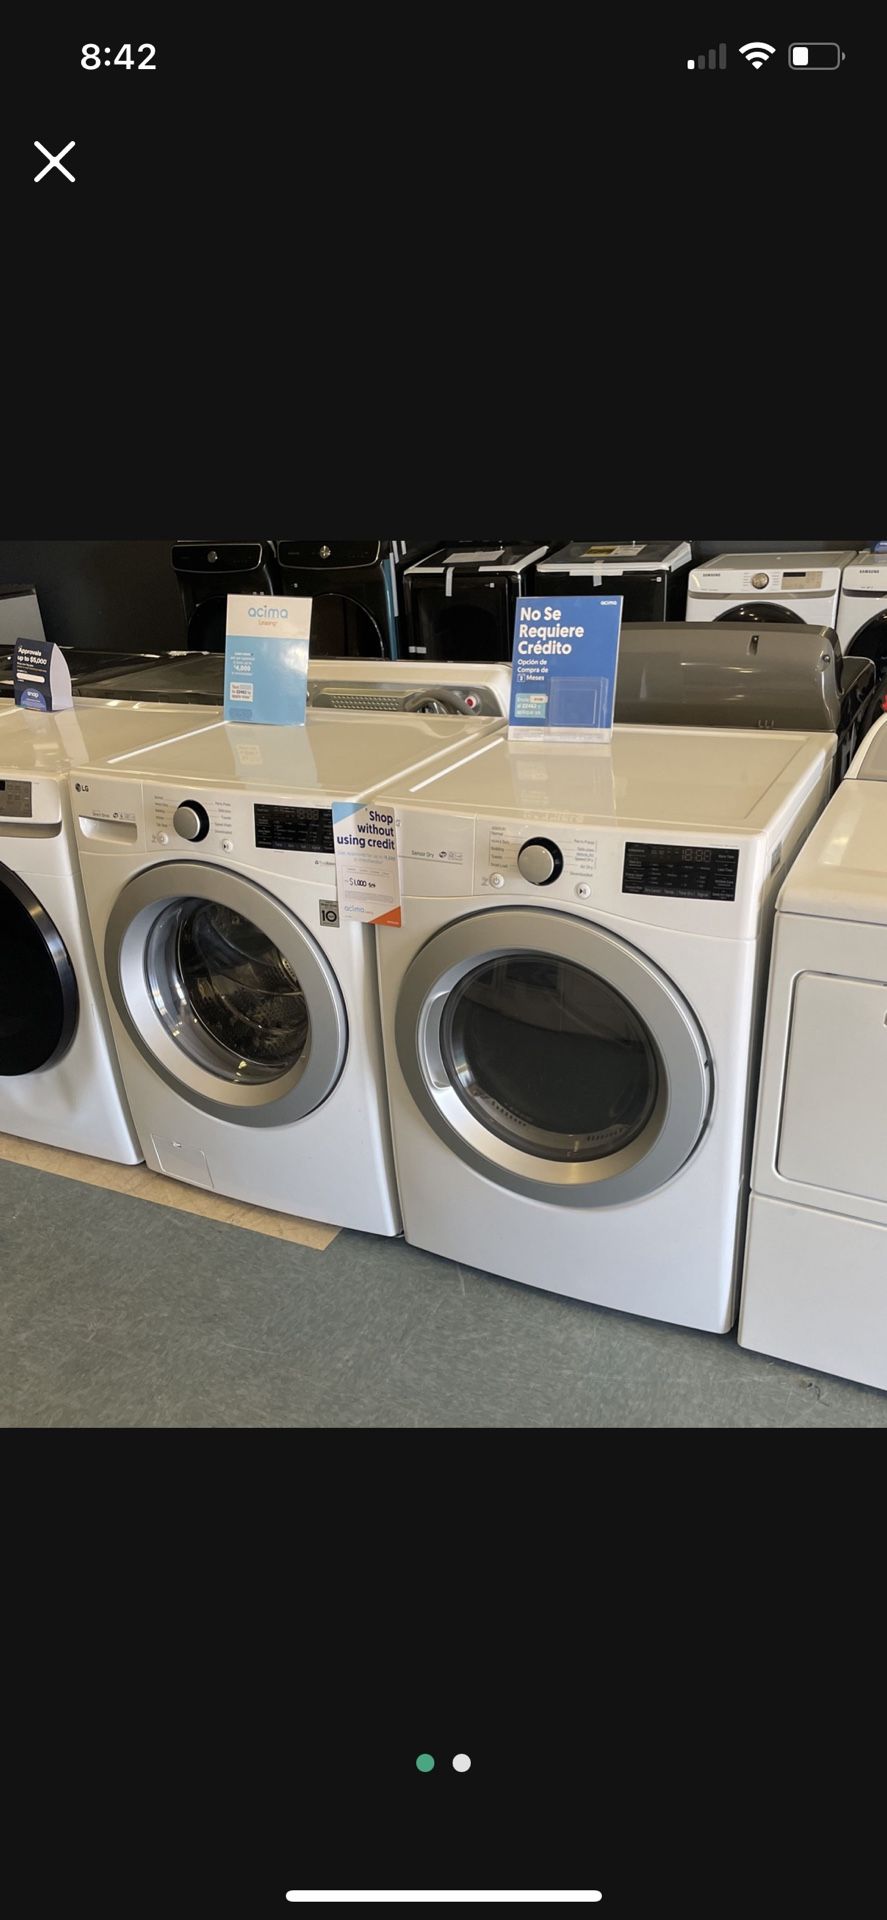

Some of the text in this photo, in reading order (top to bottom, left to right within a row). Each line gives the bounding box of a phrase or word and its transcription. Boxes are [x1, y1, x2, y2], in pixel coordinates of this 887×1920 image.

[248, 605, 289, 619] acima
[520, 606, 562, 621] No Se
[519, 623, 585, 640] Requiere
[17, 647, 42, 656] Approvals
[517, 640, 572, 655] Crédito
[29, 656, 48, 665] $5,000
[517, 658, 539, 666] Opción
[517, 666, 540, 674] Compra
[369, 810, 393, 825] Shop
[357, 824, 394, 837] without
[337, 835, 395, 850] using credit
[344, 903, 365, 913] acima
